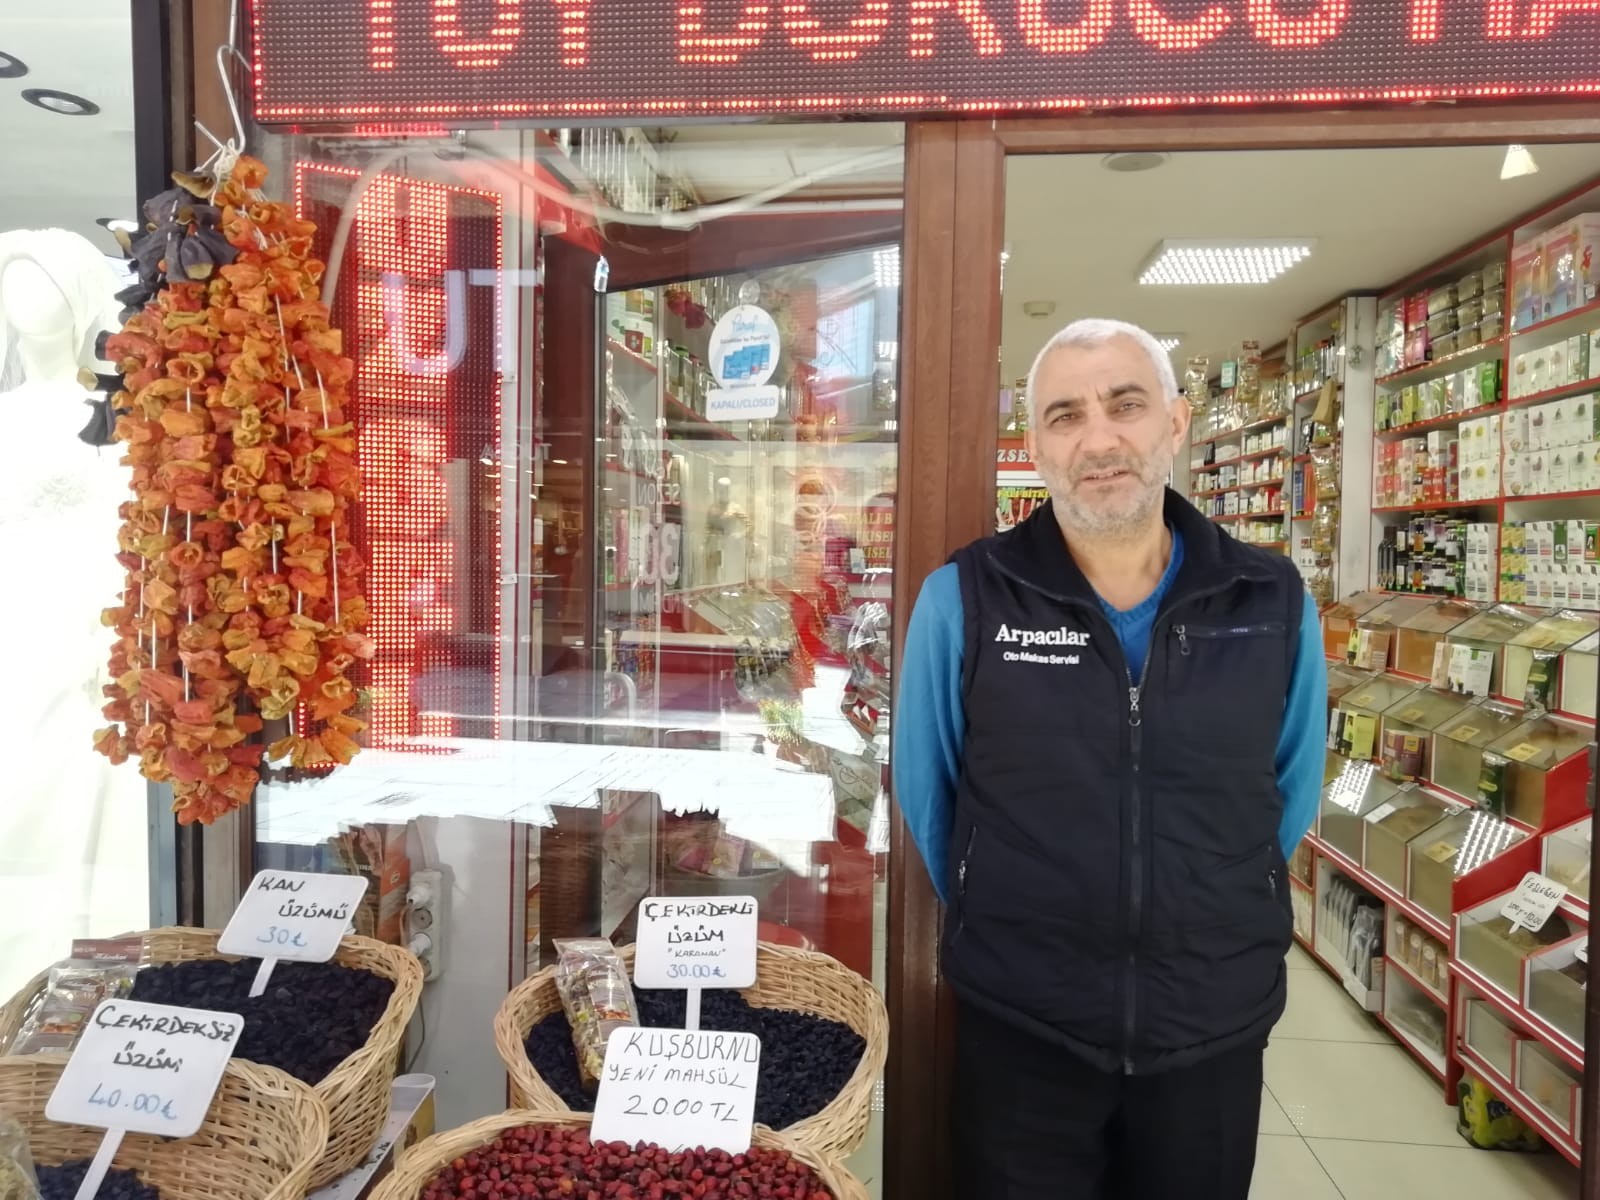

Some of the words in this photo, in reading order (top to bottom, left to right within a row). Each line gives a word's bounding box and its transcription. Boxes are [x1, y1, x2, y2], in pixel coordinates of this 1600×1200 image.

[994, 623, 1090, 647] Arpacılar
[1003, 651, 1020, 661] Oto
[1049, 654, 1080, 665] Servisi
[257, 876, 306, 893] KAN
[278, 899, 349, 920] ÜZÜMÜ
[667, 924, 724, 944] ÜZÜM
[623, 1032, 760, 1063] KUŞBURNU
[608, 1063, 658, 1082] YENİ
[664, 1067, 748, 1089] MAHSÜL
[710, 1102, 739, 1122] TL
